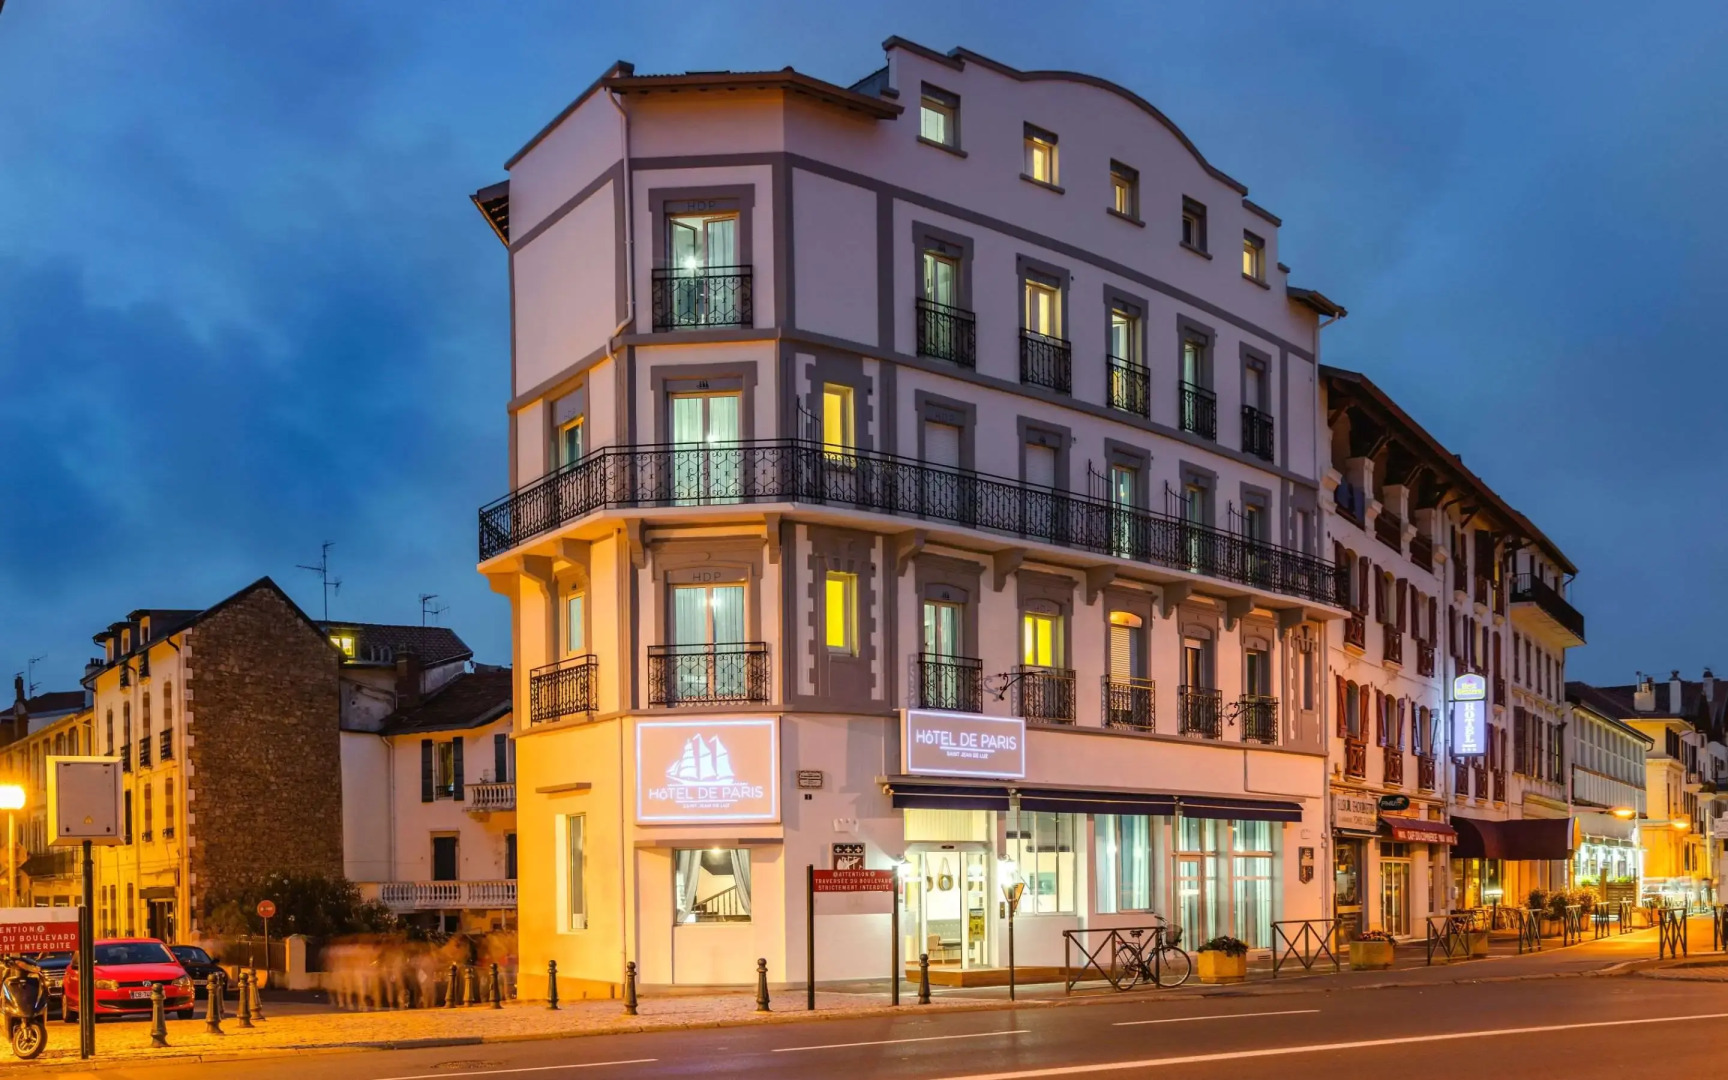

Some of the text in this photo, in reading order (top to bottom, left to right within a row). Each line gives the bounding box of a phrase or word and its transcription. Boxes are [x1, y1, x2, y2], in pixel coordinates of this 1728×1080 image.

[687, 200, 717, 211] HDP
[692, 571, 722, 582] HDP
[1464, 702, 1475, 743] HOTEL
[960, 732, 978, 747] DE
[981, 734, 1017, 750] PARIS
[698, 787, 718, 799] DE
[722, 786, 764, 799] PARIS
[3, 933, 76, 943] DU BOULEVARD
[20, 942, 71, 951] INTERDITE
